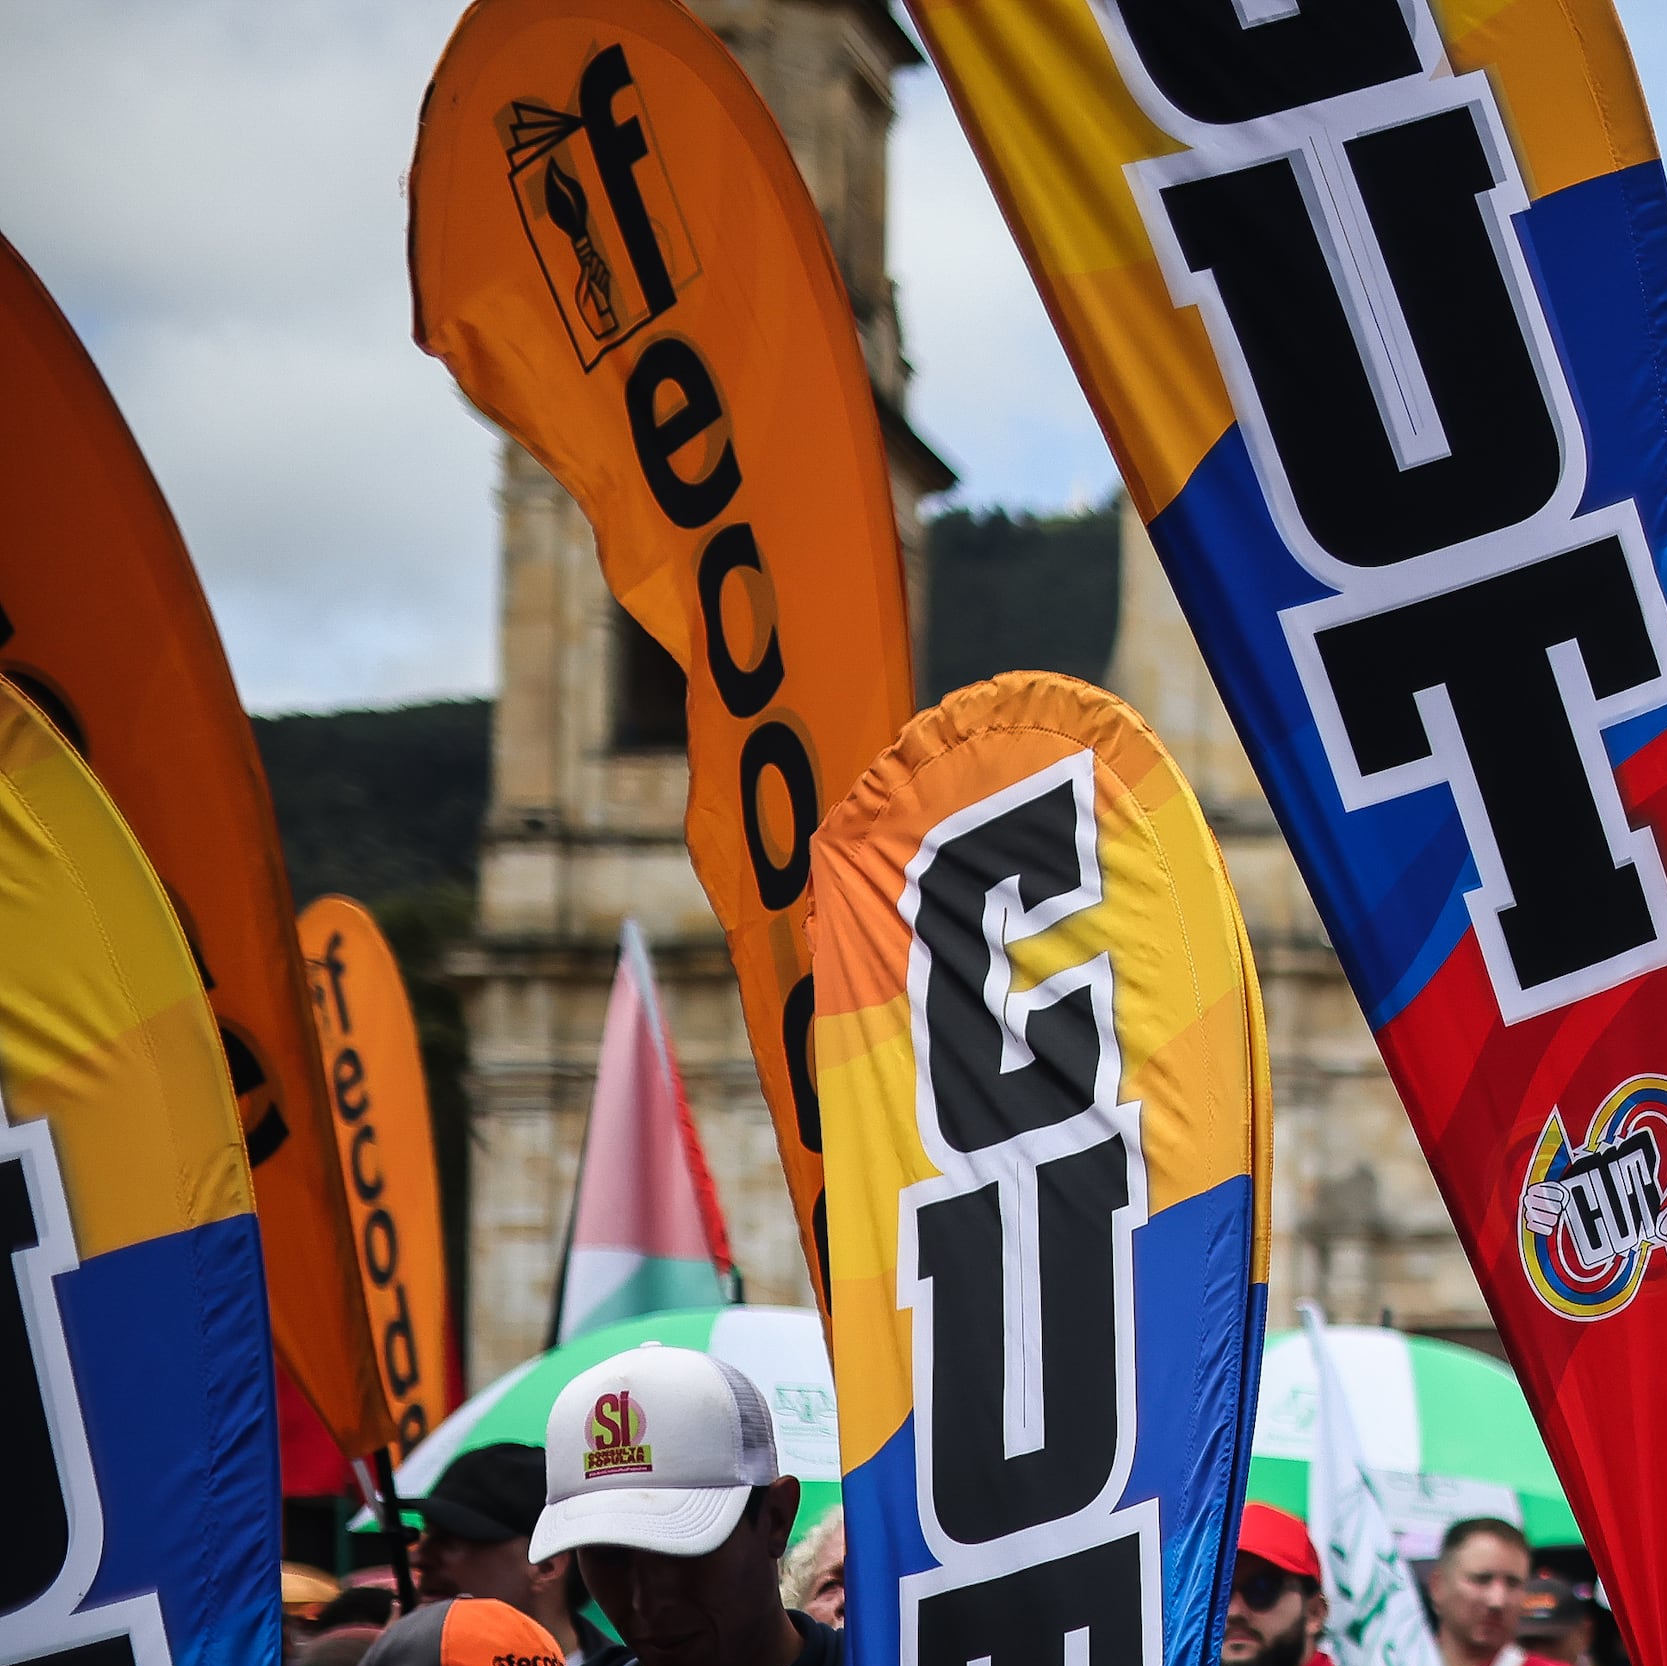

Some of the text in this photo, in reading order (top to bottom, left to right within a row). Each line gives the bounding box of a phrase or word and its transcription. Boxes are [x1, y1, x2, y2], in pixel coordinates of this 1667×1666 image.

[580, 44, 831, 1316] feco
[327, 929, 427, 1450] fecode
[1561, 1147, 1656, 1267] CUT
